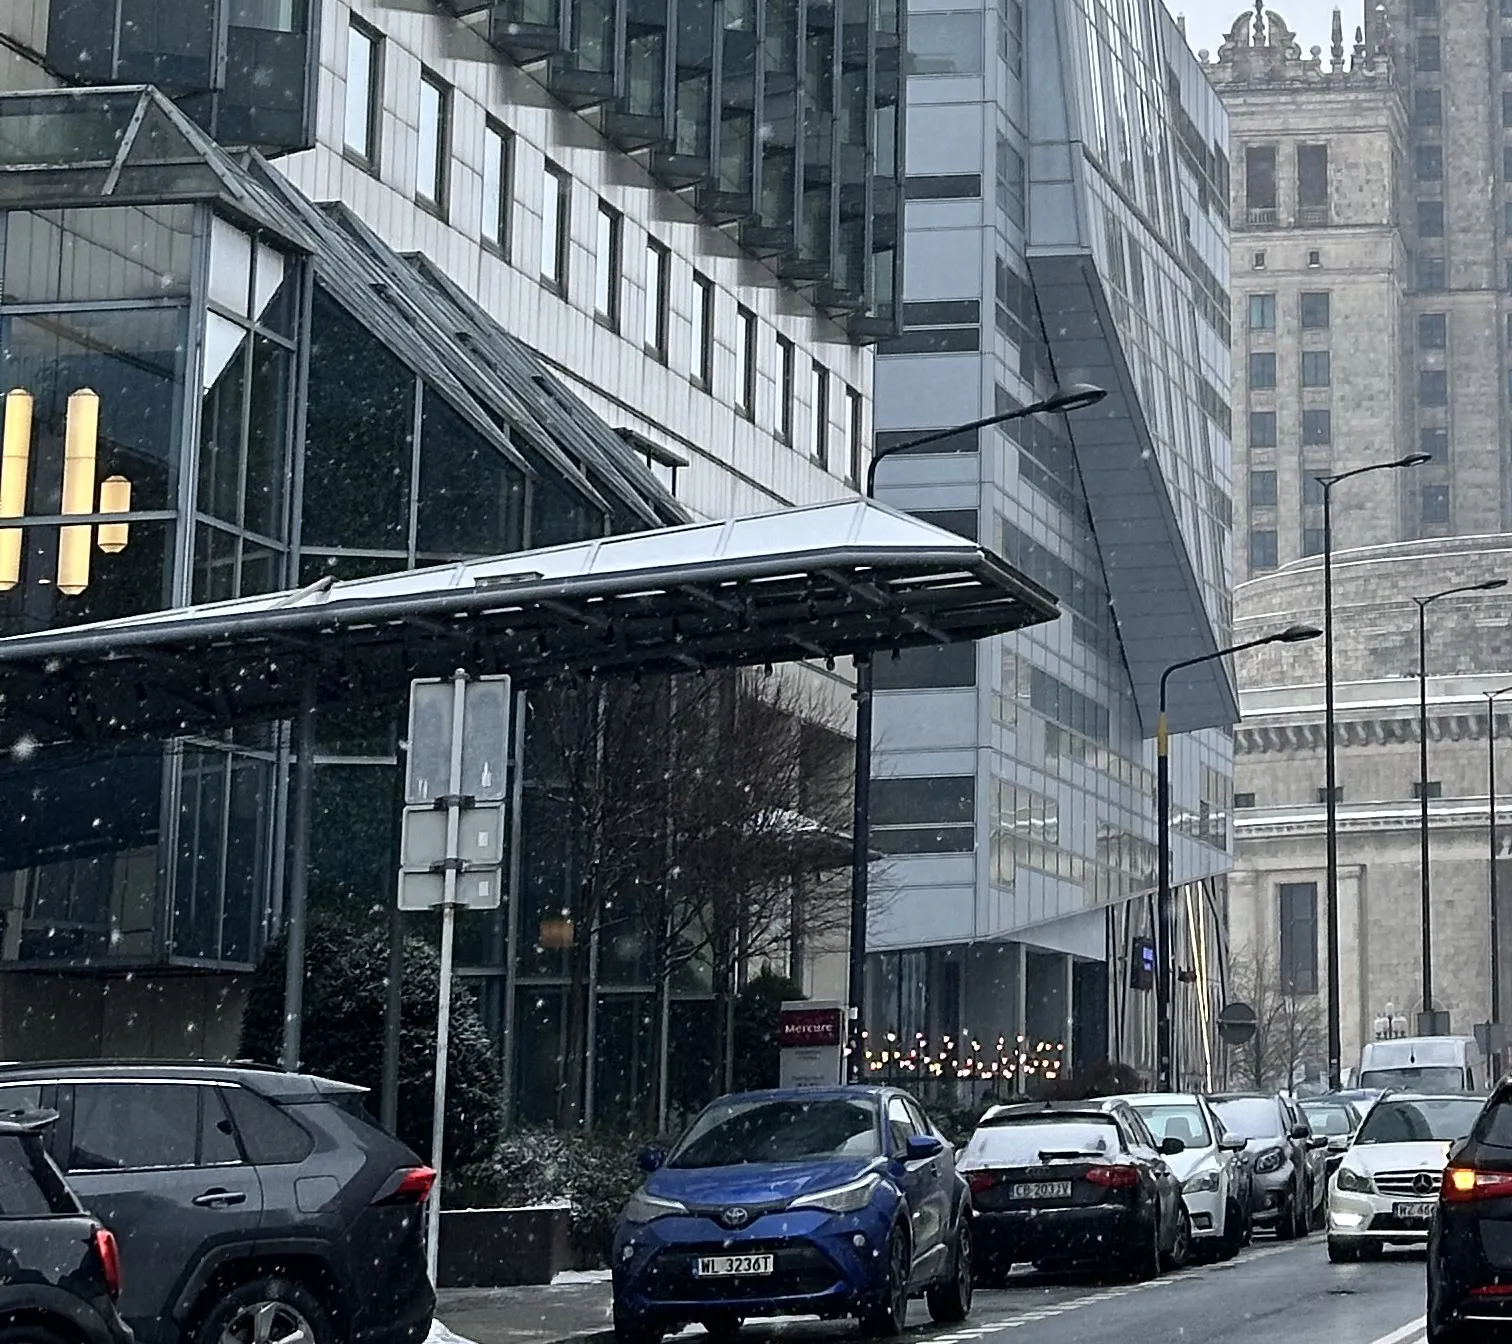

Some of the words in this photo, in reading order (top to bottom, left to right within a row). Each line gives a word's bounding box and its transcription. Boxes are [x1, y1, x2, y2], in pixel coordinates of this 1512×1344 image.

[784, 1024, 833, 1034] Mercure
[701, 1258, 721, 1273] WL
[726, 1255, 771, 1273] 3236T
